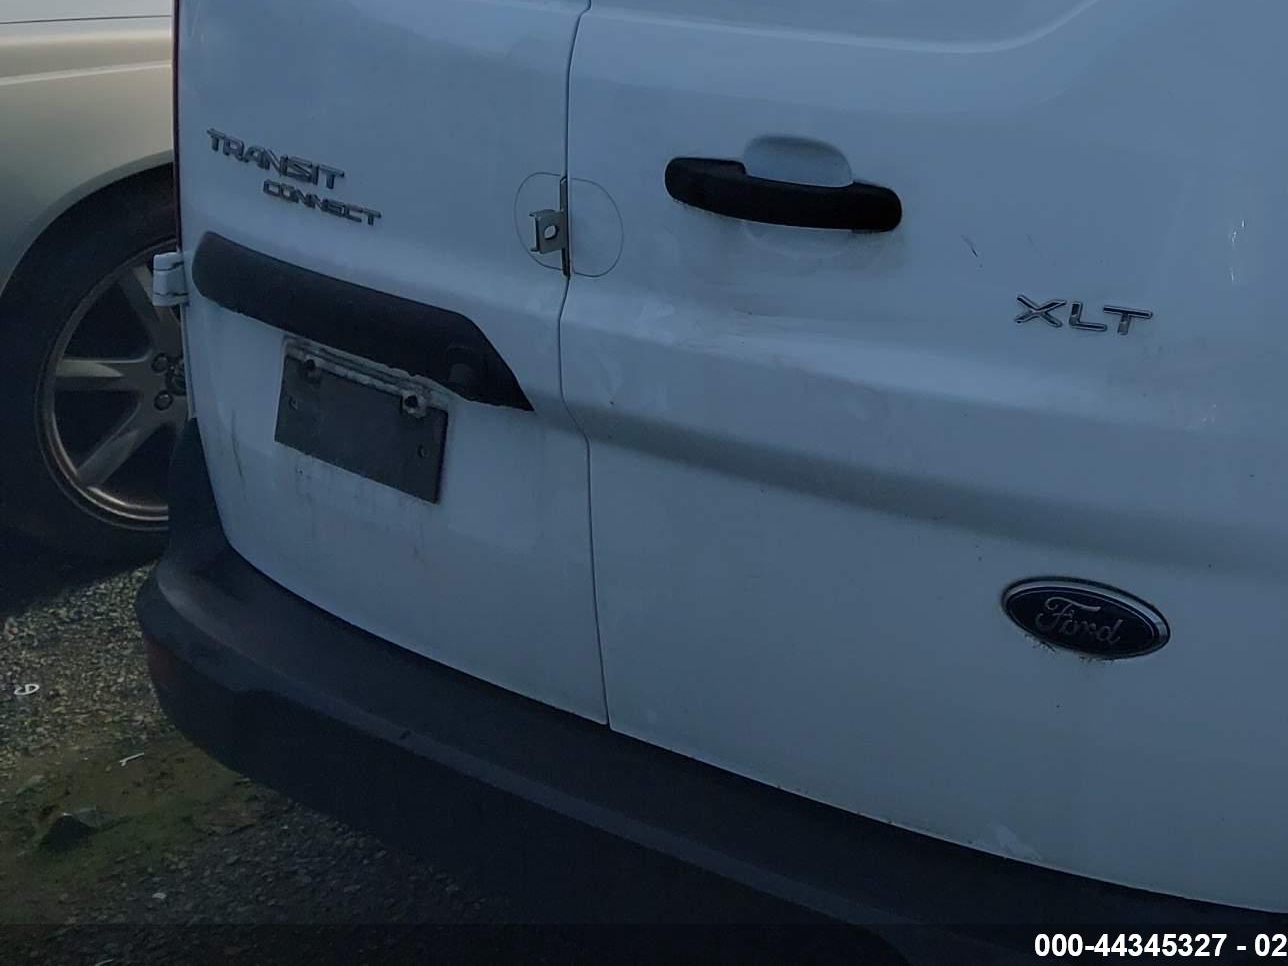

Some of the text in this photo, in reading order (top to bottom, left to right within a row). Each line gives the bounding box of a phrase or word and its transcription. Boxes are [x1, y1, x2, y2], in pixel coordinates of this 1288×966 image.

[207, 128, 345, 190] TRANSIT
[263, 179, 382, 226] CONNECT
[1015, 294, 1153, 335] XLT
[1036, 596, 1124, 644] Ford
